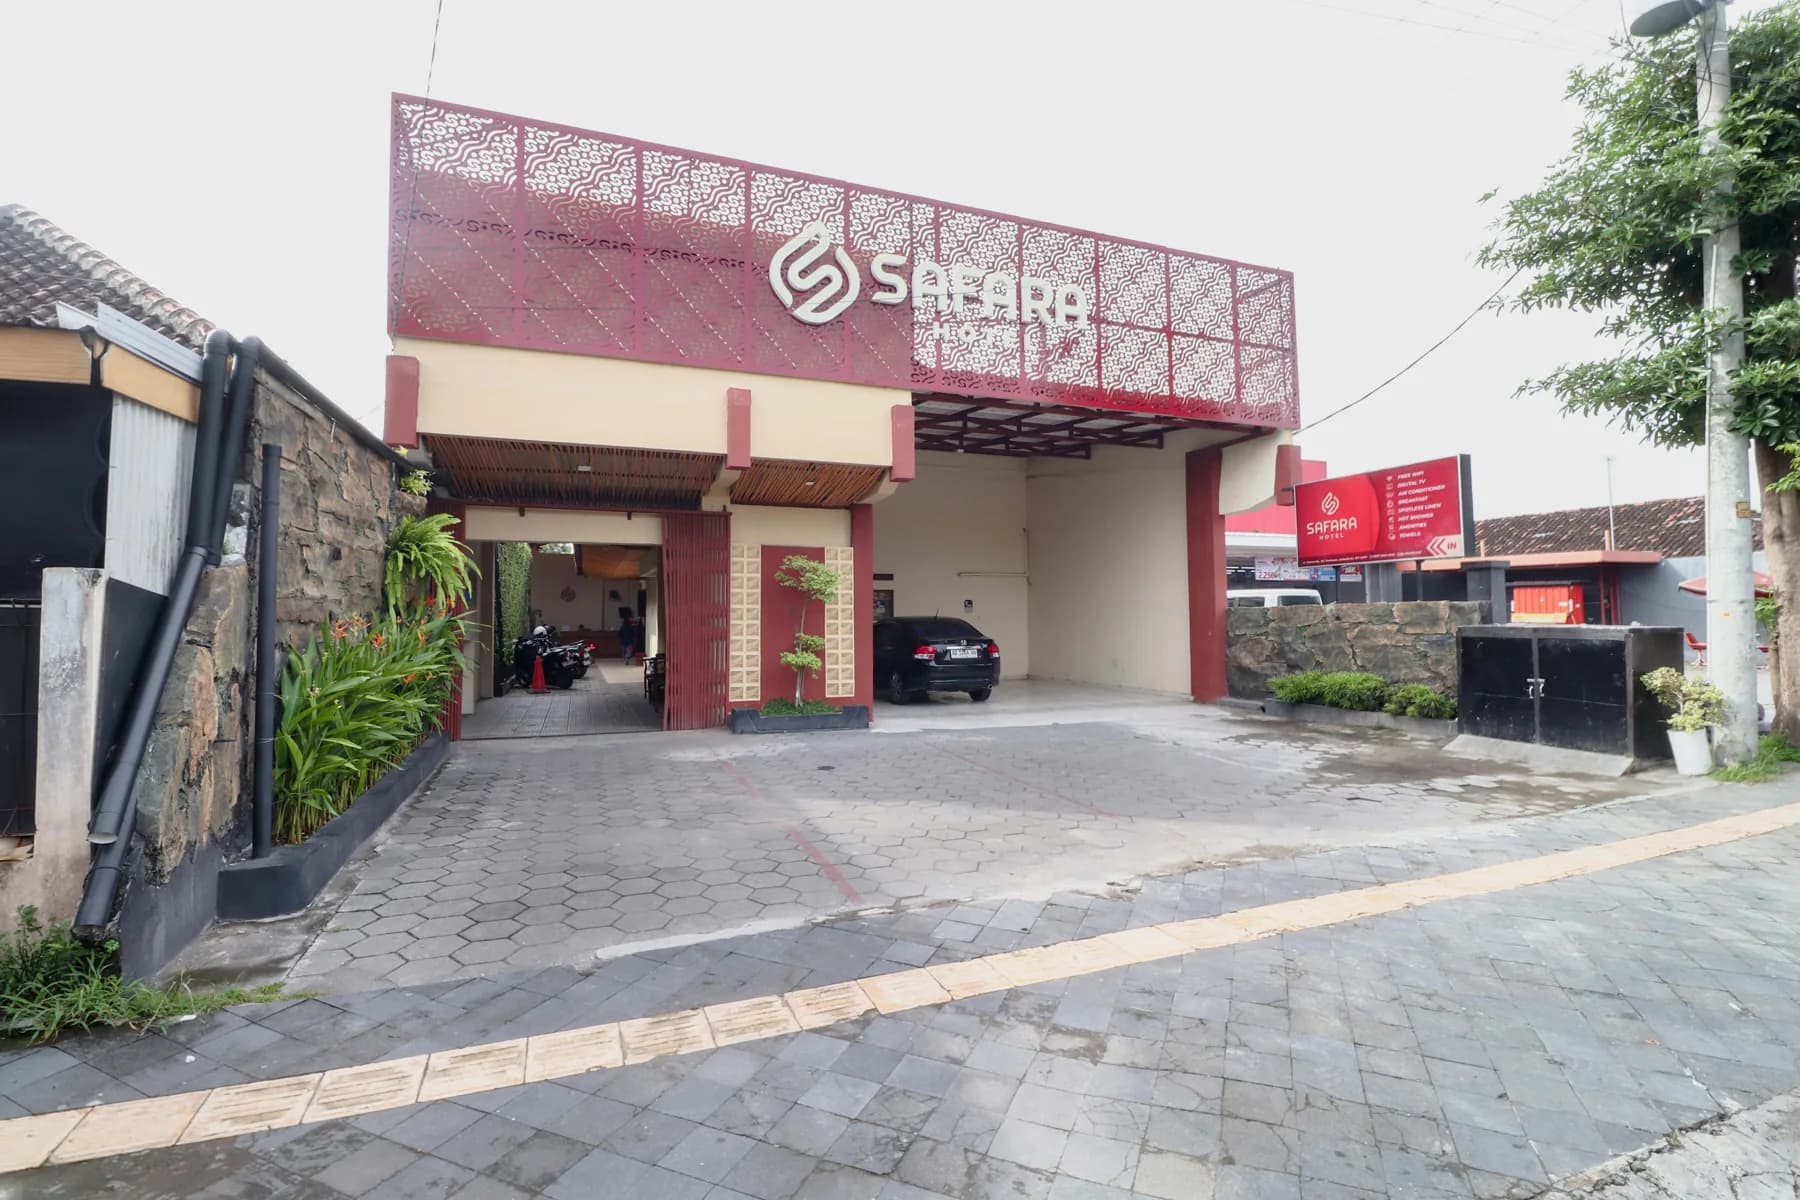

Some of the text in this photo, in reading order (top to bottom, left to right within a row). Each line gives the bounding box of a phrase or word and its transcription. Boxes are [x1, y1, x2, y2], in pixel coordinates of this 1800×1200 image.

[870, 253, 1089, 330] SAFARA
[932, 321, 1040, 352] HOTEL
[1306, 516, 1357, 535] SAFARA
[1319, 533, 1344, 541] HOTEL
[1447, 542, 1456, 550] IN
